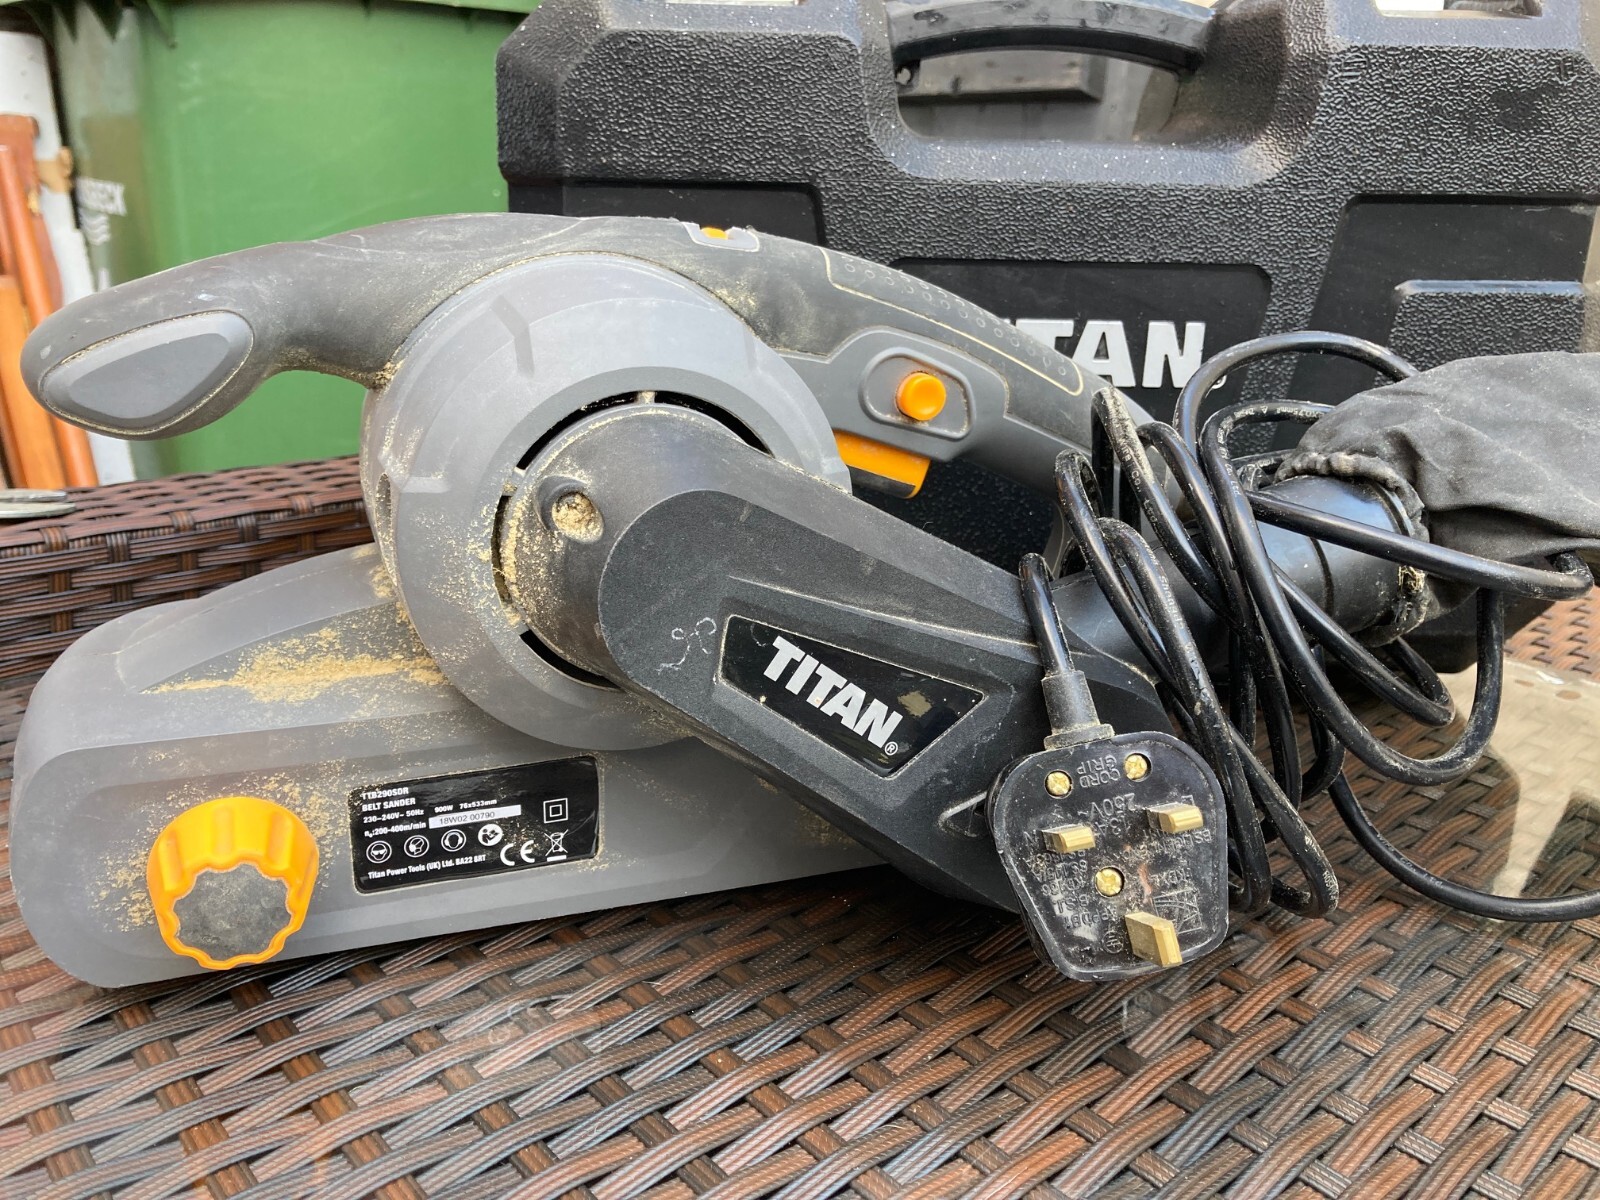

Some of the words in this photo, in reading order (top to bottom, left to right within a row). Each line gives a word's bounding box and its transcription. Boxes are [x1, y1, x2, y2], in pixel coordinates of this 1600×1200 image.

[1001, 318, 1206, 389] TAN
[763, 635, 903, 749] TITAN
[1077, 755, 1117, 774] GRIP
[1079, 768, 1121, 789] CORD
[361, 787, 409, 800] TTB290SDR
[362, 803, 381, 811] BELT
[383, 798, 416, 809] SANDER
[406, 809, 424, 817] 50Hz
[434, 805, 454, 813] 900W
[459, 799, 498, 810] 76x533mm
[440, 815, 468, 825] 18W02
[470, 811, 496, 821] 00790
[368, 870, 386, 879] Titan
[386, 866, 407, 876] Power
[408, 864, 426, 873] Tools
[426, 860, 441, 871] (UK)
[442, 858, 455, 868] Ltd.
